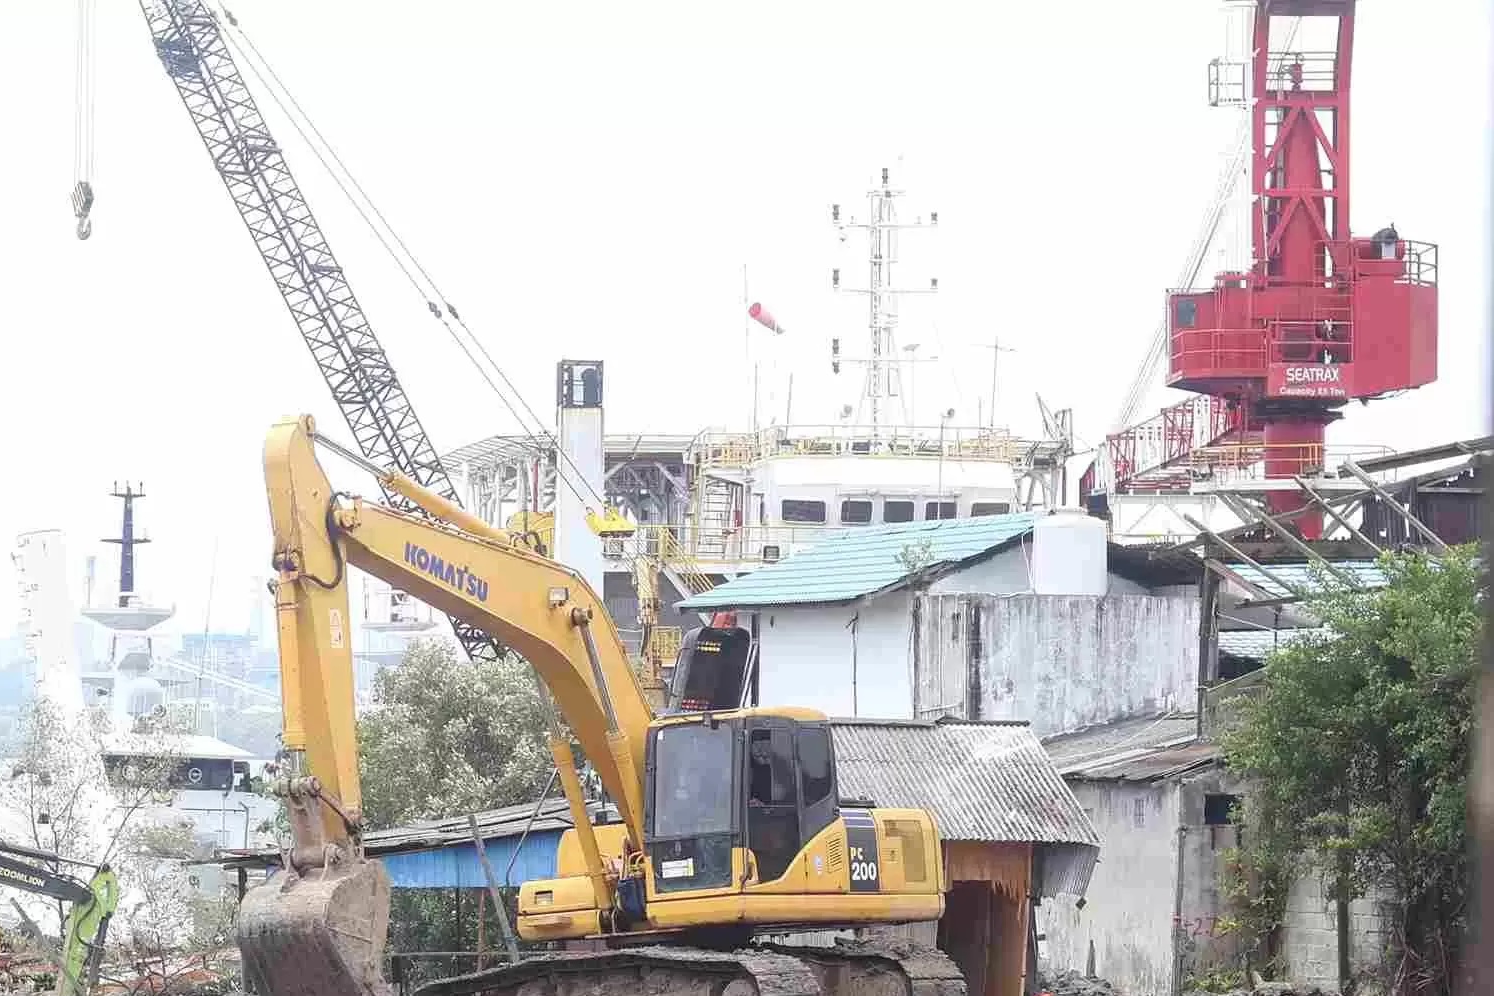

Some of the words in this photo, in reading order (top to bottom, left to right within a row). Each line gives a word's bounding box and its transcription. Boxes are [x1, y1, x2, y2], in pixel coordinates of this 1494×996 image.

[1286, 367, 1339, 382] SEATRAX
[404, 541, 488, 602] KOMATSU
[850, 847, 863, 860] PC
[851, 862, 877, 881] 200
